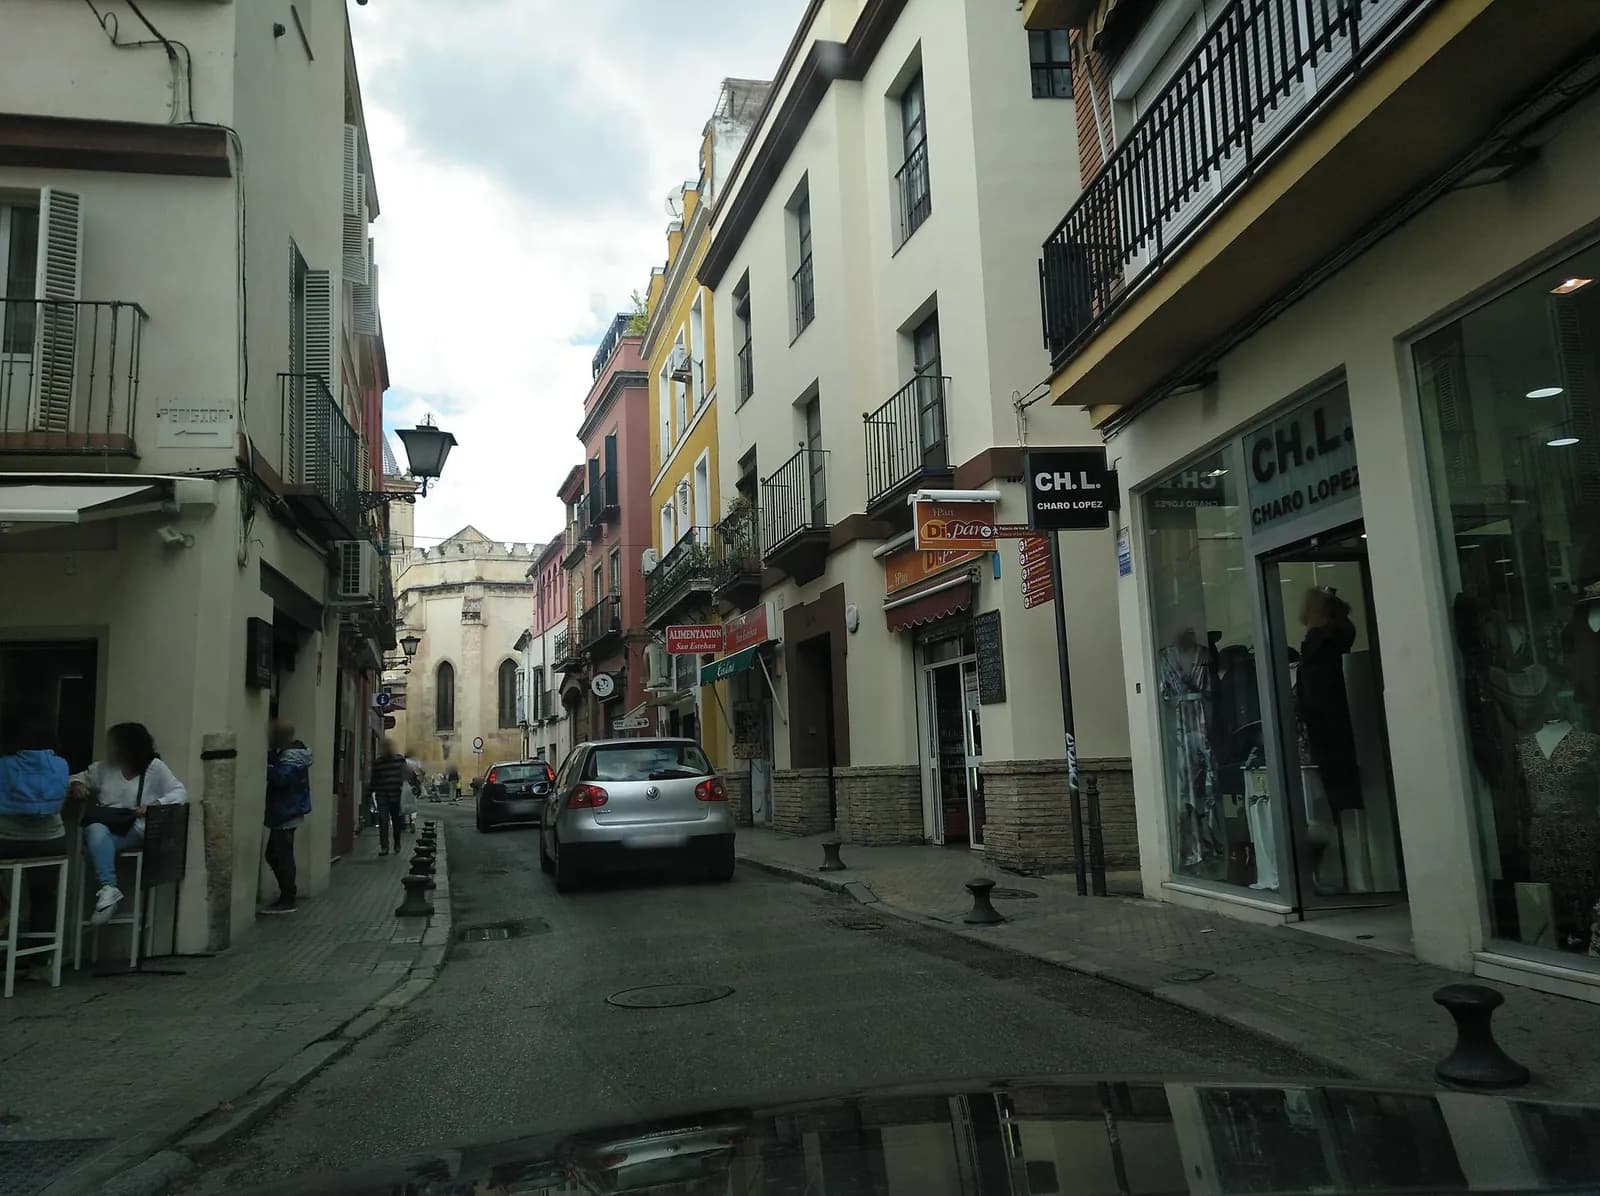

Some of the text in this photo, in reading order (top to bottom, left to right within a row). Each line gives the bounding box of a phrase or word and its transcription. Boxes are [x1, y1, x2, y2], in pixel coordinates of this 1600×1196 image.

[1037, 501, 1104, 510] CHARO LOPEZ
[1252, 490, 1303, 526] CHARO
[669, 629, 722, 640] ALIMENTACION
[675, 641, 716, 650] San Esteban
